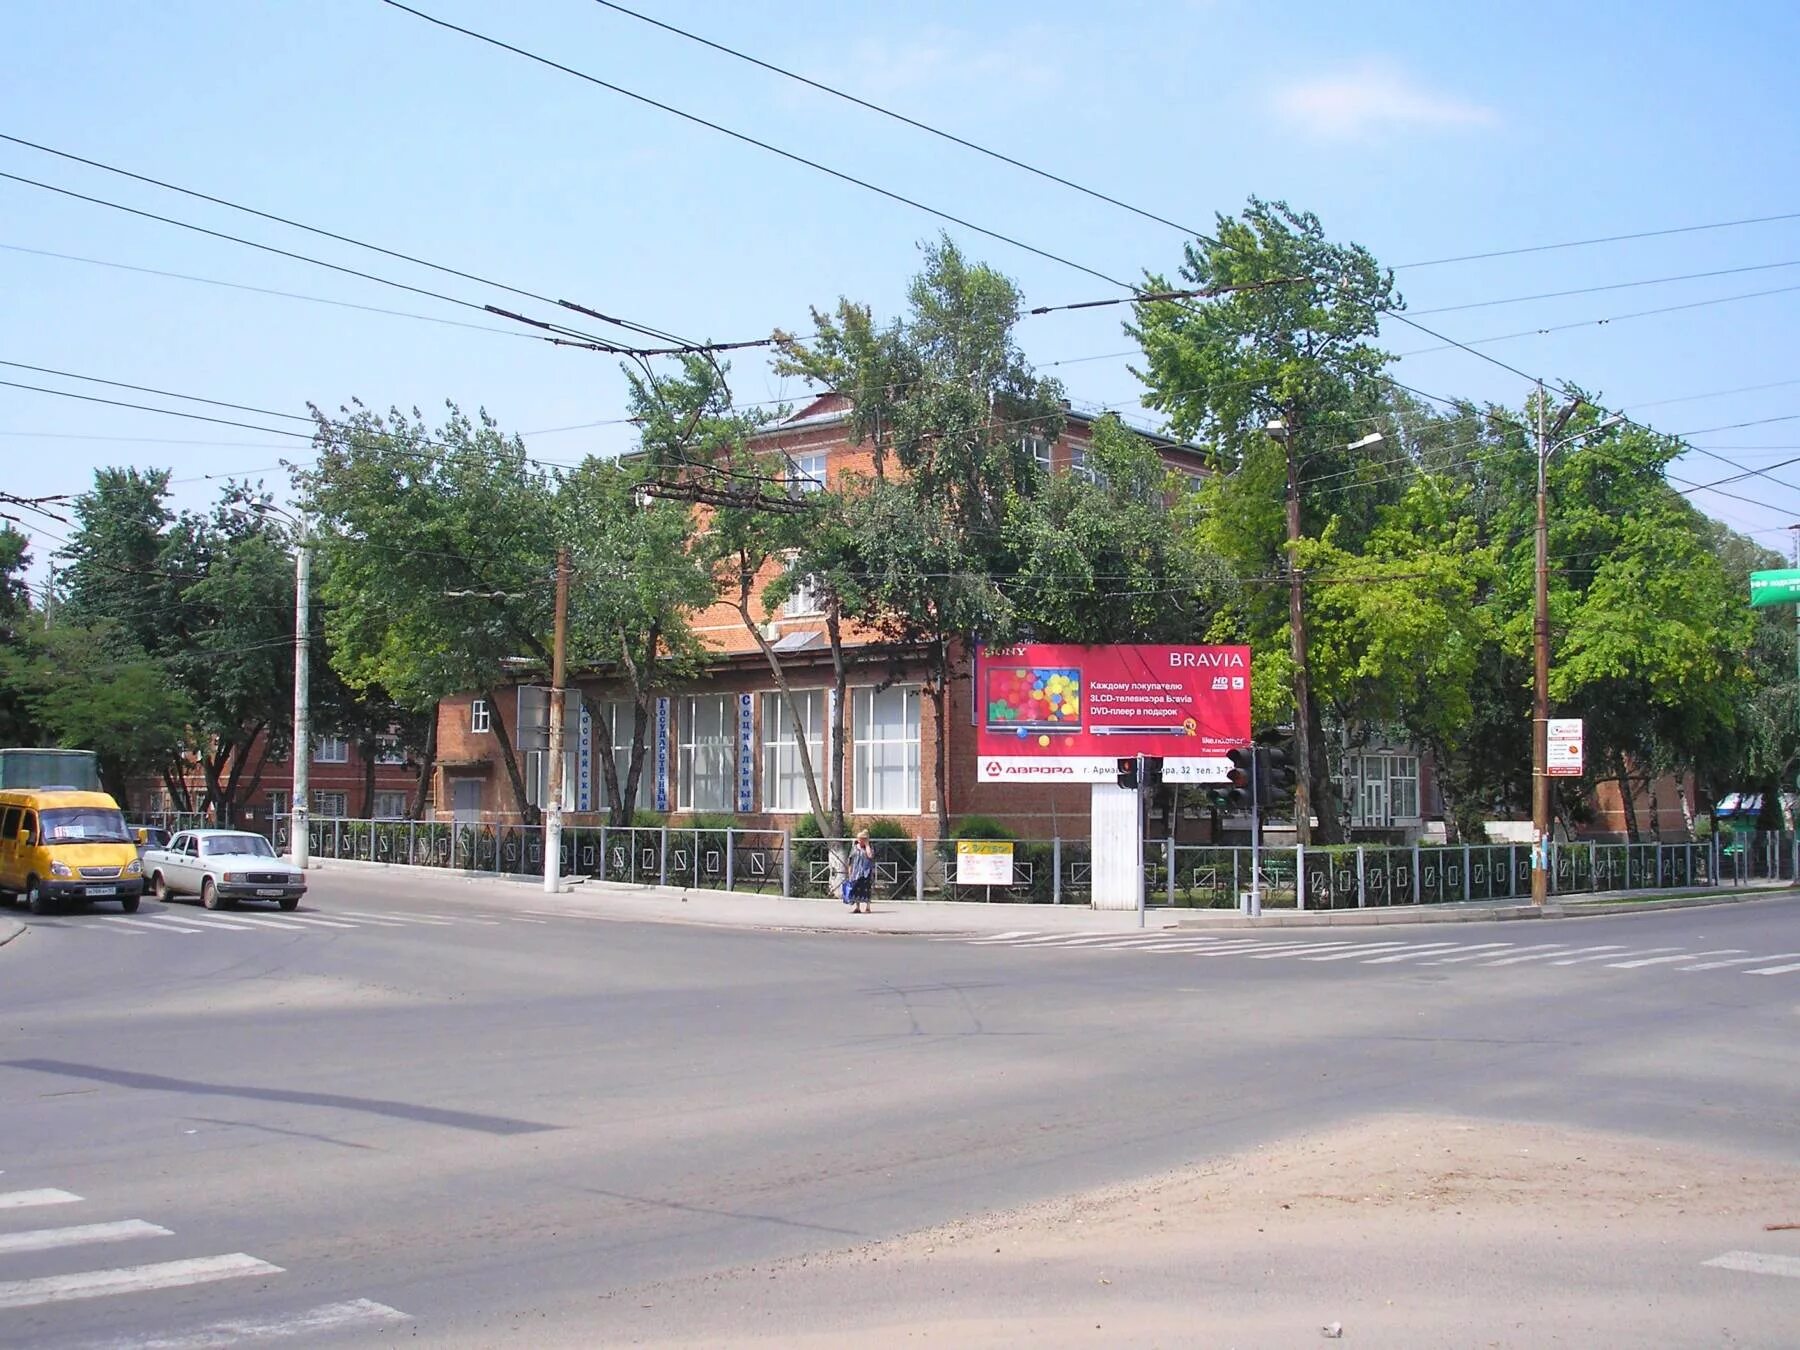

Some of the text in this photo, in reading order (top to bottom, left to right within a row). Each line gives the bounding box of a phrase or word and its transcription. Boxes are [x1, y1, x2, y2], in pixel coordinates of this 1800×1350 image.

[1170, 652, 1244, 667] BRAVIA
[1090, 681, 1183, 691] Каждому покупателю
[1090, 707, 1135, 717] DVD-плеер
[1143, 709, 1178, 717] подарок
[1006, 766, 1074, 774] АВРОРА
[1181, 766, 1191, 774] 32
